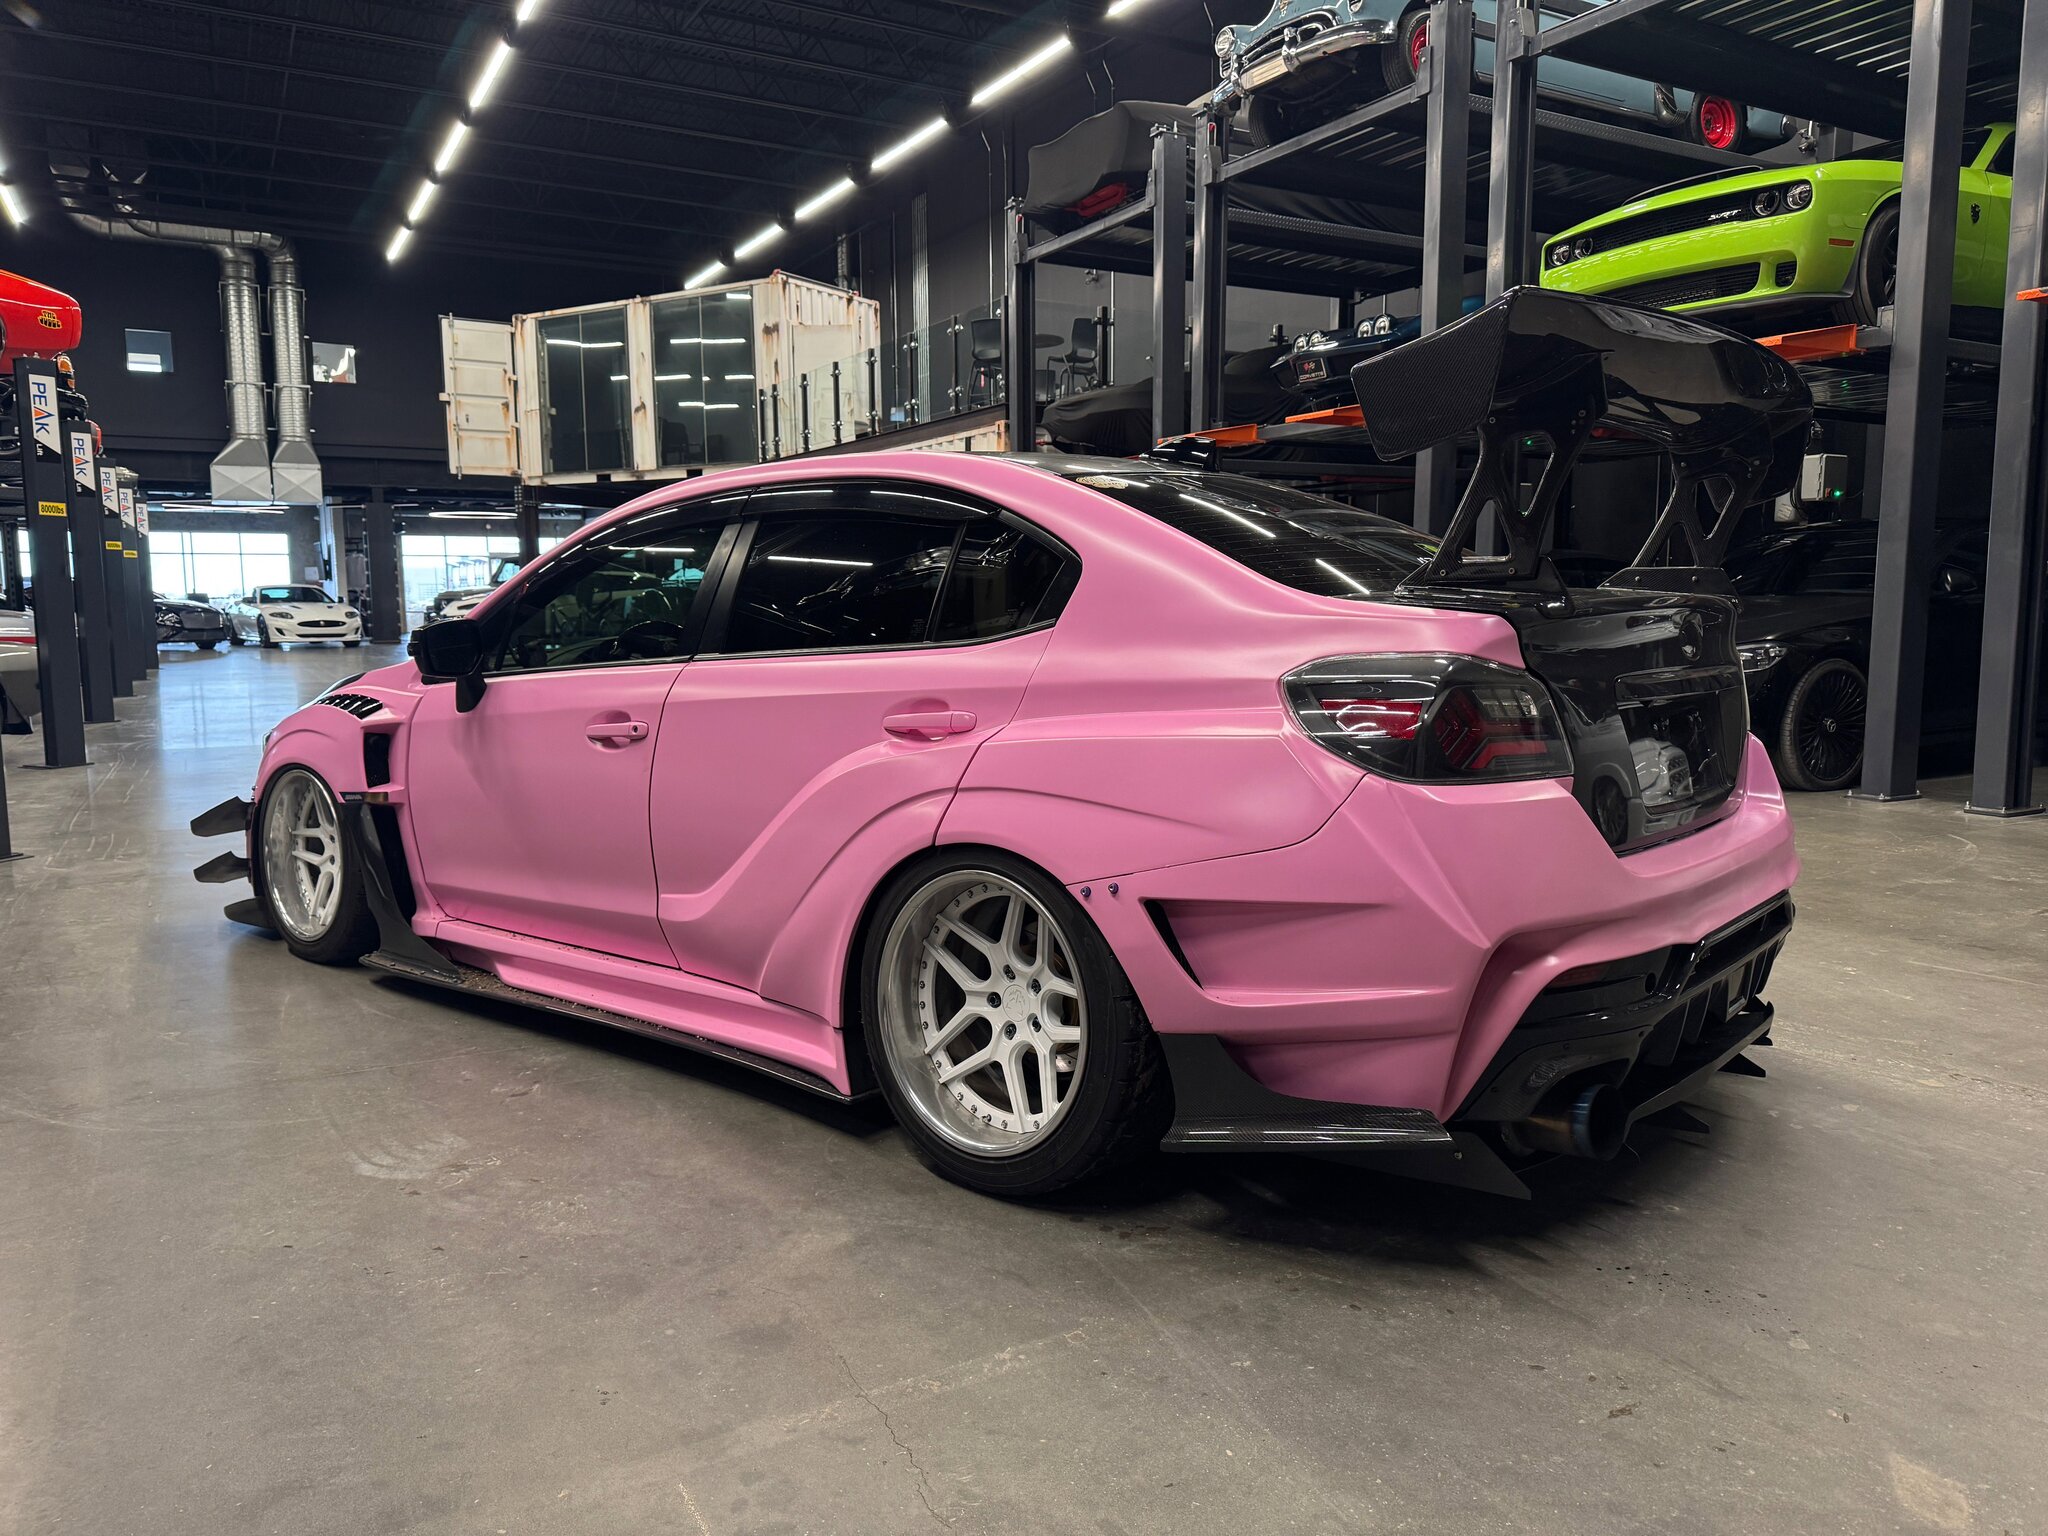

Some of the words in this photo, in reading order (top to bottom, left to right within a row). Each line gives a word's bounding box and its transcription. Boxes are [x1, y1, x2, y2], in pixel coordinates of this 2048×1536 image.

[31, 381, 55, 435] PEAK
[73, 437, 91, 477] PEAK
[102, 471, 115, 503] PEAK
[120, 491, 132, 518] PEAK
[137, 506, 147, 529] PEAK
